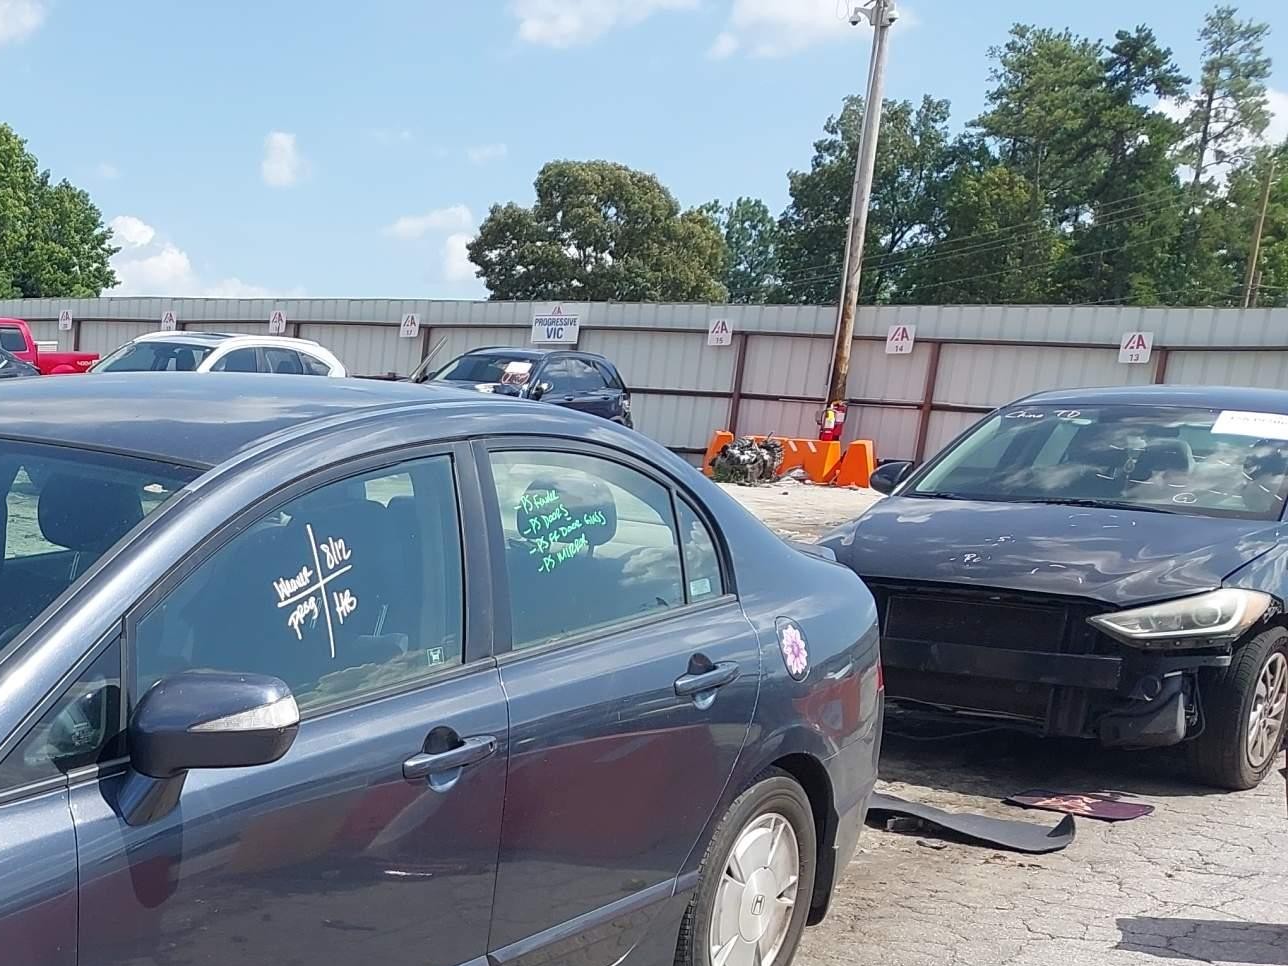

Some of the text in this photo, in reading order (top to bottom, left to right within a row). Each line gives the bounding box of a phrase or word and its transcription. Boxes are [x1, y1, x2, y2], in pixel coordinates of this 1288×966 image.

[534, 317, 578, 327] PROGRESSIVE
[546, 327, 564, 340] VIC
[320, 536, 352, 570] 8/12
